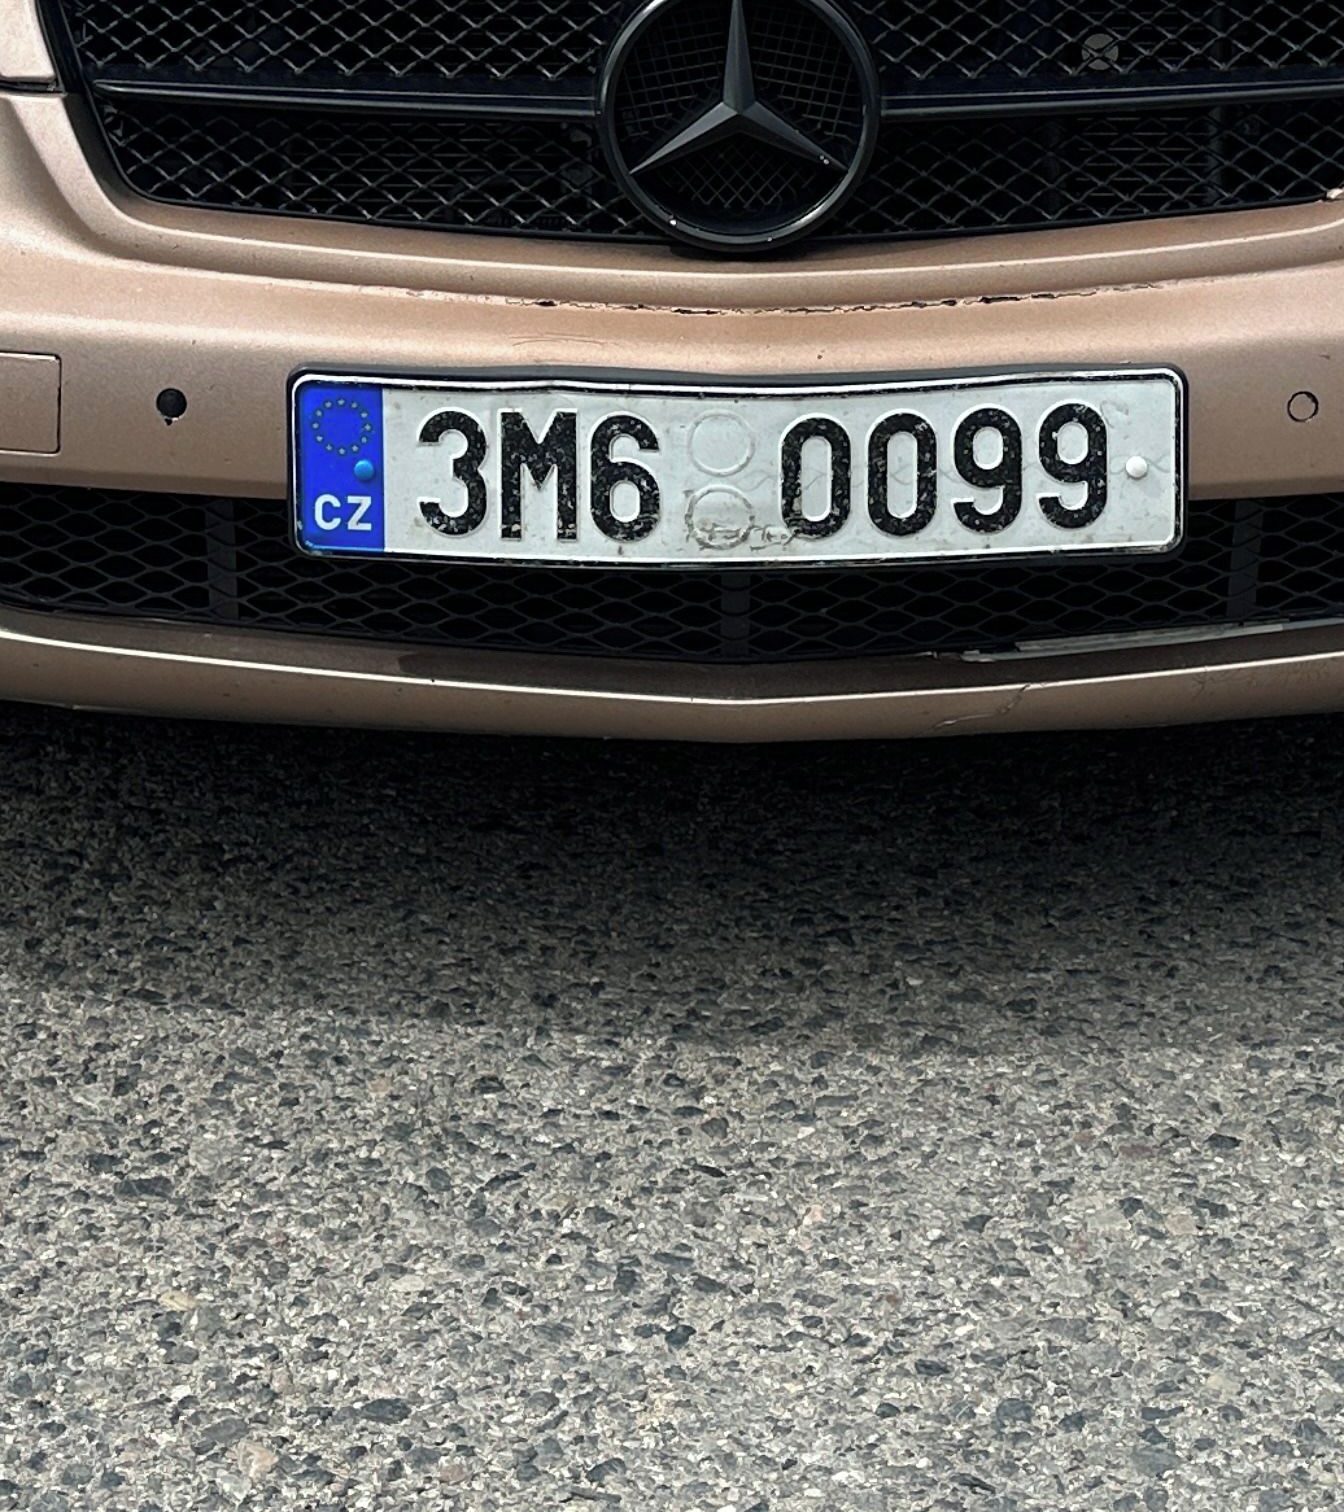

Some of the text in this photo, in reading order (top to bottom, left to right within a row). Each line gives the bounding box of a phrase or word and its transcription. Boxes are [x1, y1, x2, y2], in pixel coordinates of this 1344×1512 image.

[314, 494, 372, 531] CZ
[418, 404, 1108, 542] 3M6 0099
